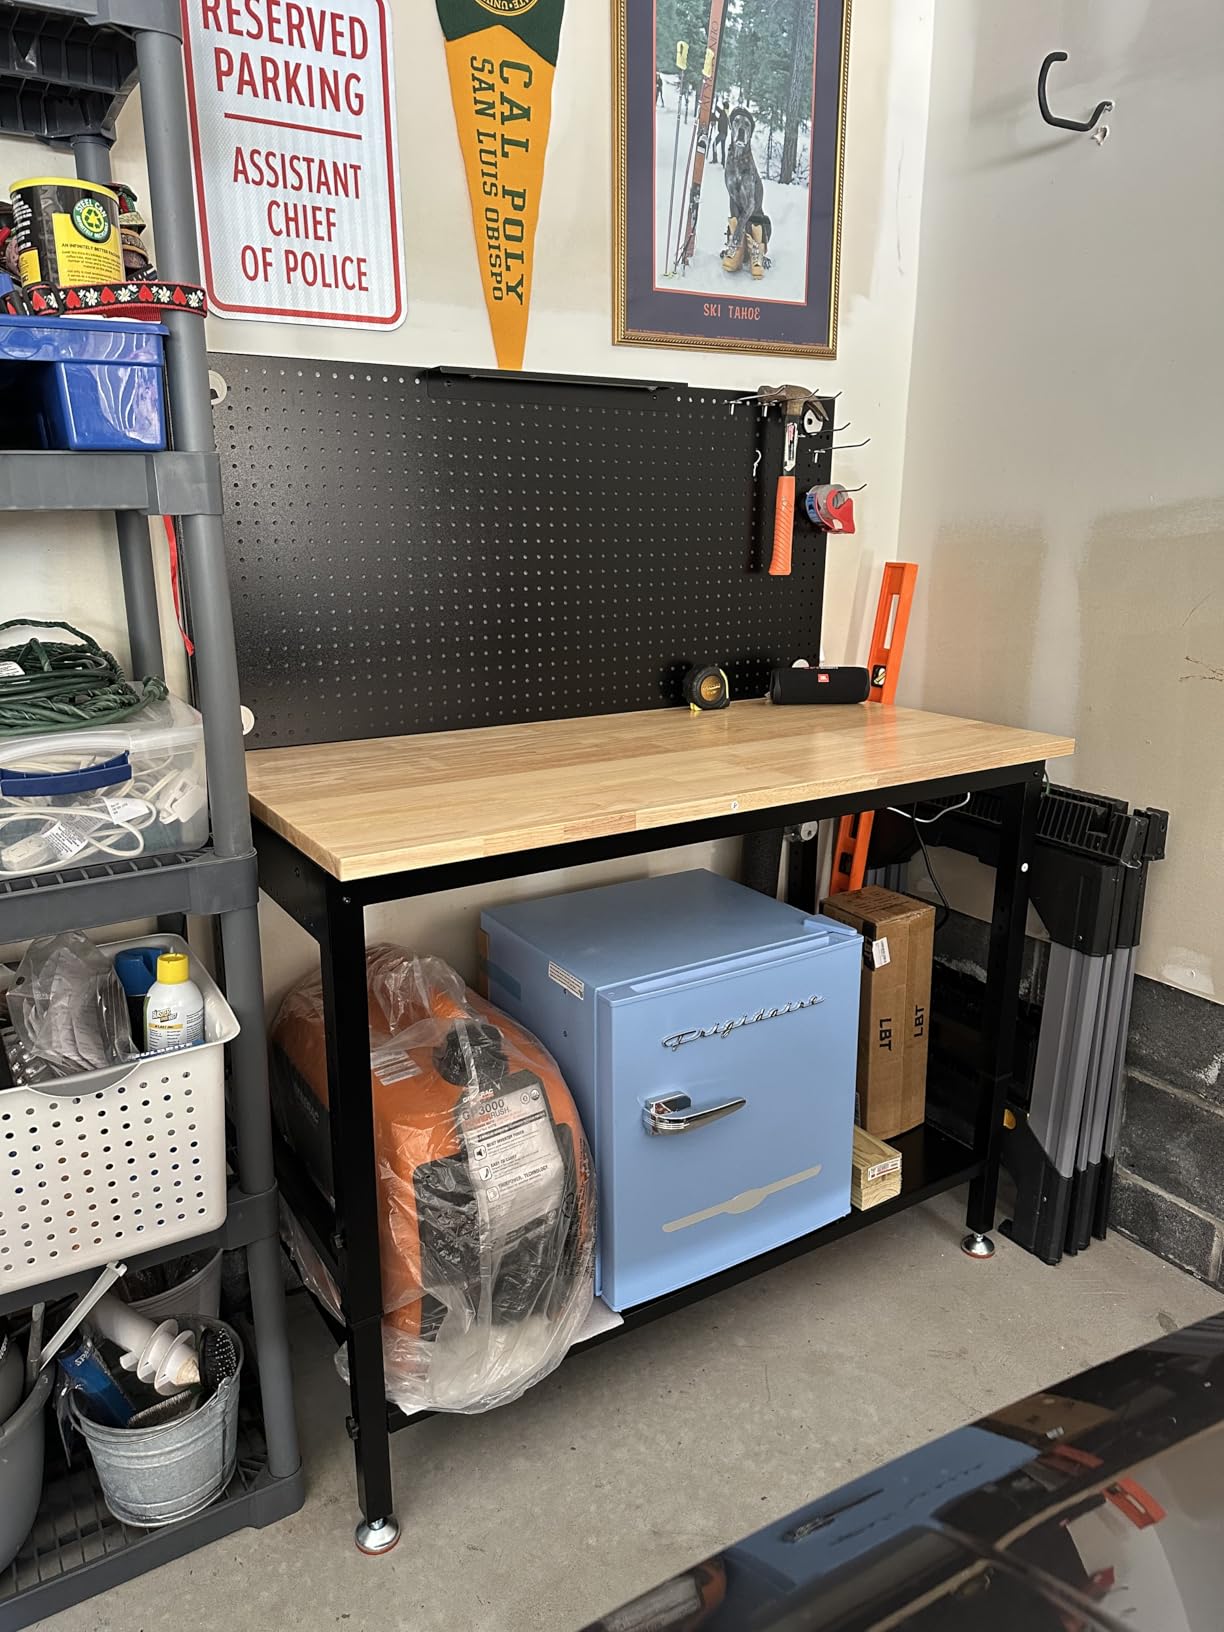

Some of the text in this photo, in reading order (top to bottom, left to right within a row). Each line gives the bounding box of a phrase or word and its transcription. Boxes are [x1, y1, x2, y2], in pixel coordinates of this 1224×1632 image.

[202, 0, 369, 60] RESERVED
[214, 47, 364, 116] PARKING
[233, 146, 362, 199] ASSISTANT
[470, 55, 504, 301] SAN LUIS OBISPO
[499, 58, 533, 305] CAL POLY
[75, 199, 107, 217] STEEL CAN
[267, 200, 336, 242] CHIEF
[241, 244, 369, 291] OF POLICE
[703, 303, 761, 321] SKI TAHOE
[661, 995, 826, 1051] Frigidaire
[879, 1018, 892, 1051] LBT
[914, 1004, 924, 1037] LBT
